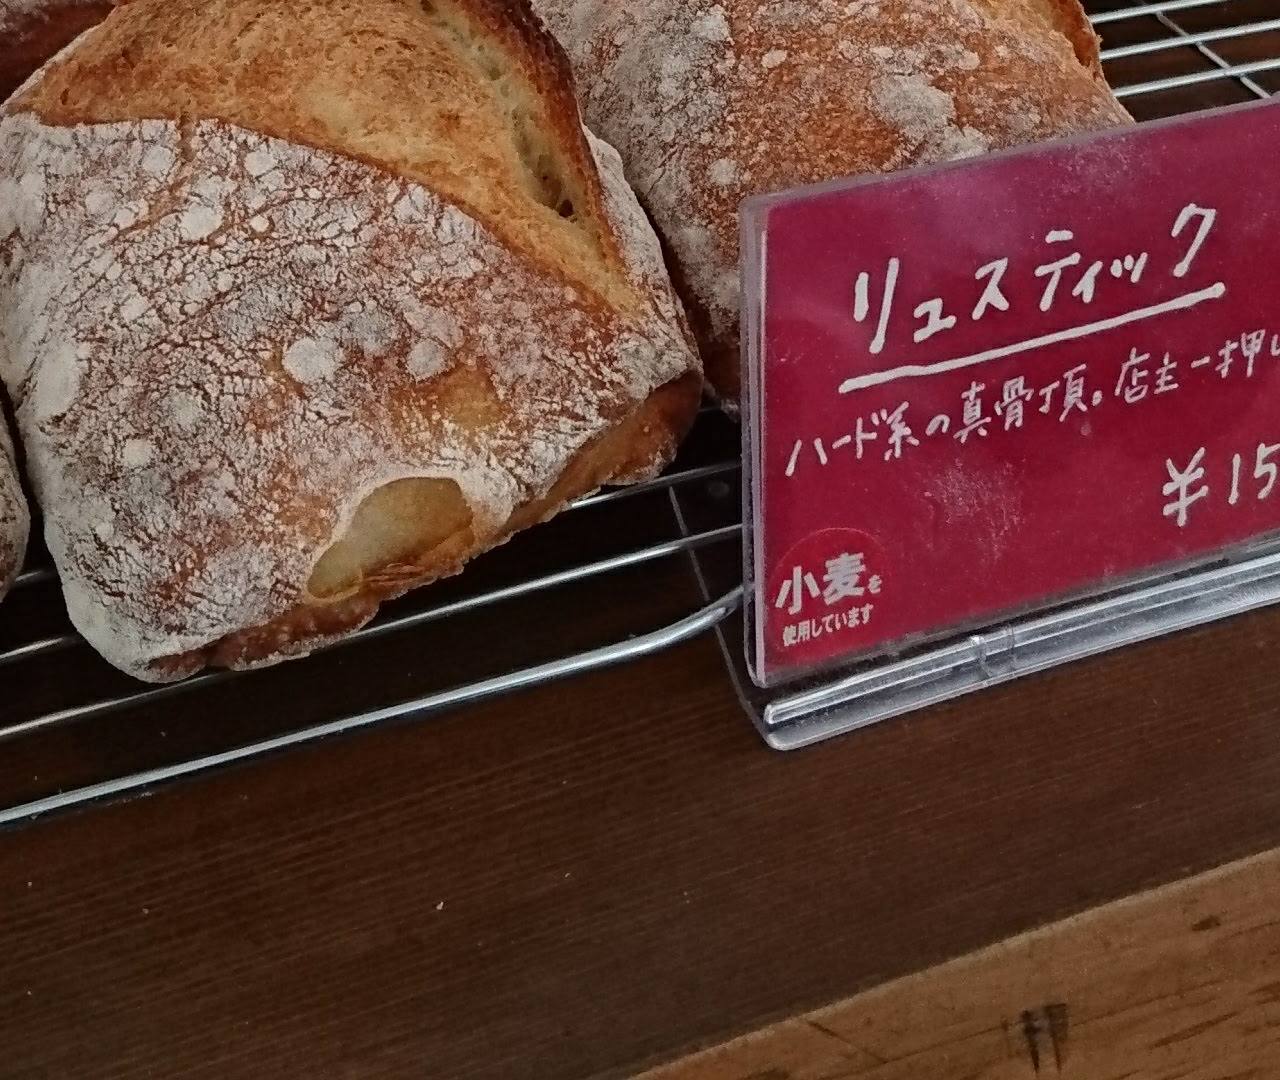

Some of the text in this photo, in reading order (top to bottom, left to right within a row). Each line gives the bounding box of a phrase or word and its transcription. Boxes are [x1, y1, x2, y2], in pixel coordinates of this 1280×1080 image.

[853, 203, 1217, 355] リュスティック
[783, 603, 874, 647] 使用しています
